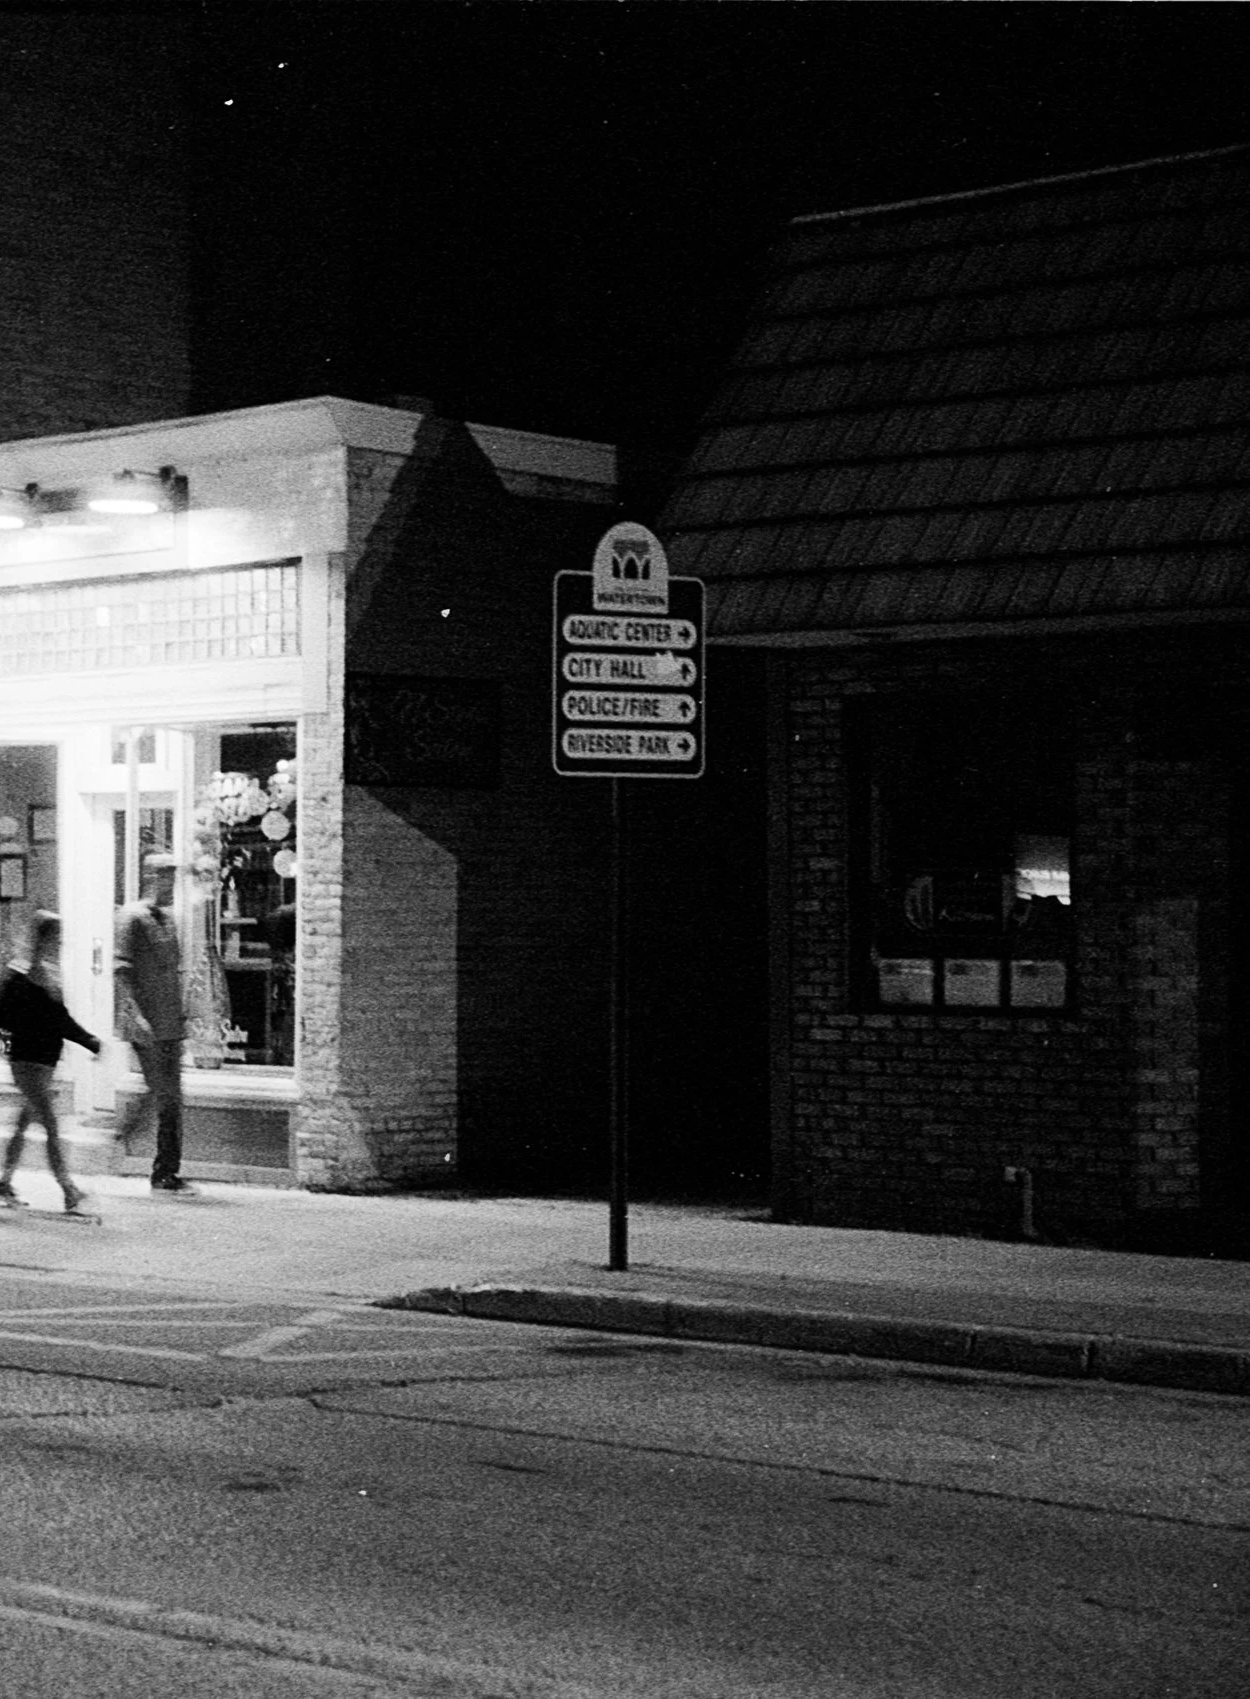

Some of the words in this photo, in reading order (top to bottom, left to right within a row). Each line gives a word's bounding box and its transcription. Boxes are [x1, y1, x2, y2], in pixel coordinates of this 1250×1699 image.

[569, 619, 619, 641] AQUATIC
[625, 622, 671, 643] CENTER
[567, 657, 600, 678] CITY
[609, 659, 646, 680] HALL
[567, 696, 661, 717] POLICE/FIRE
[567, 734, 632, 755] RIVERSIDE
[638, 736, 671, 756] PARK
